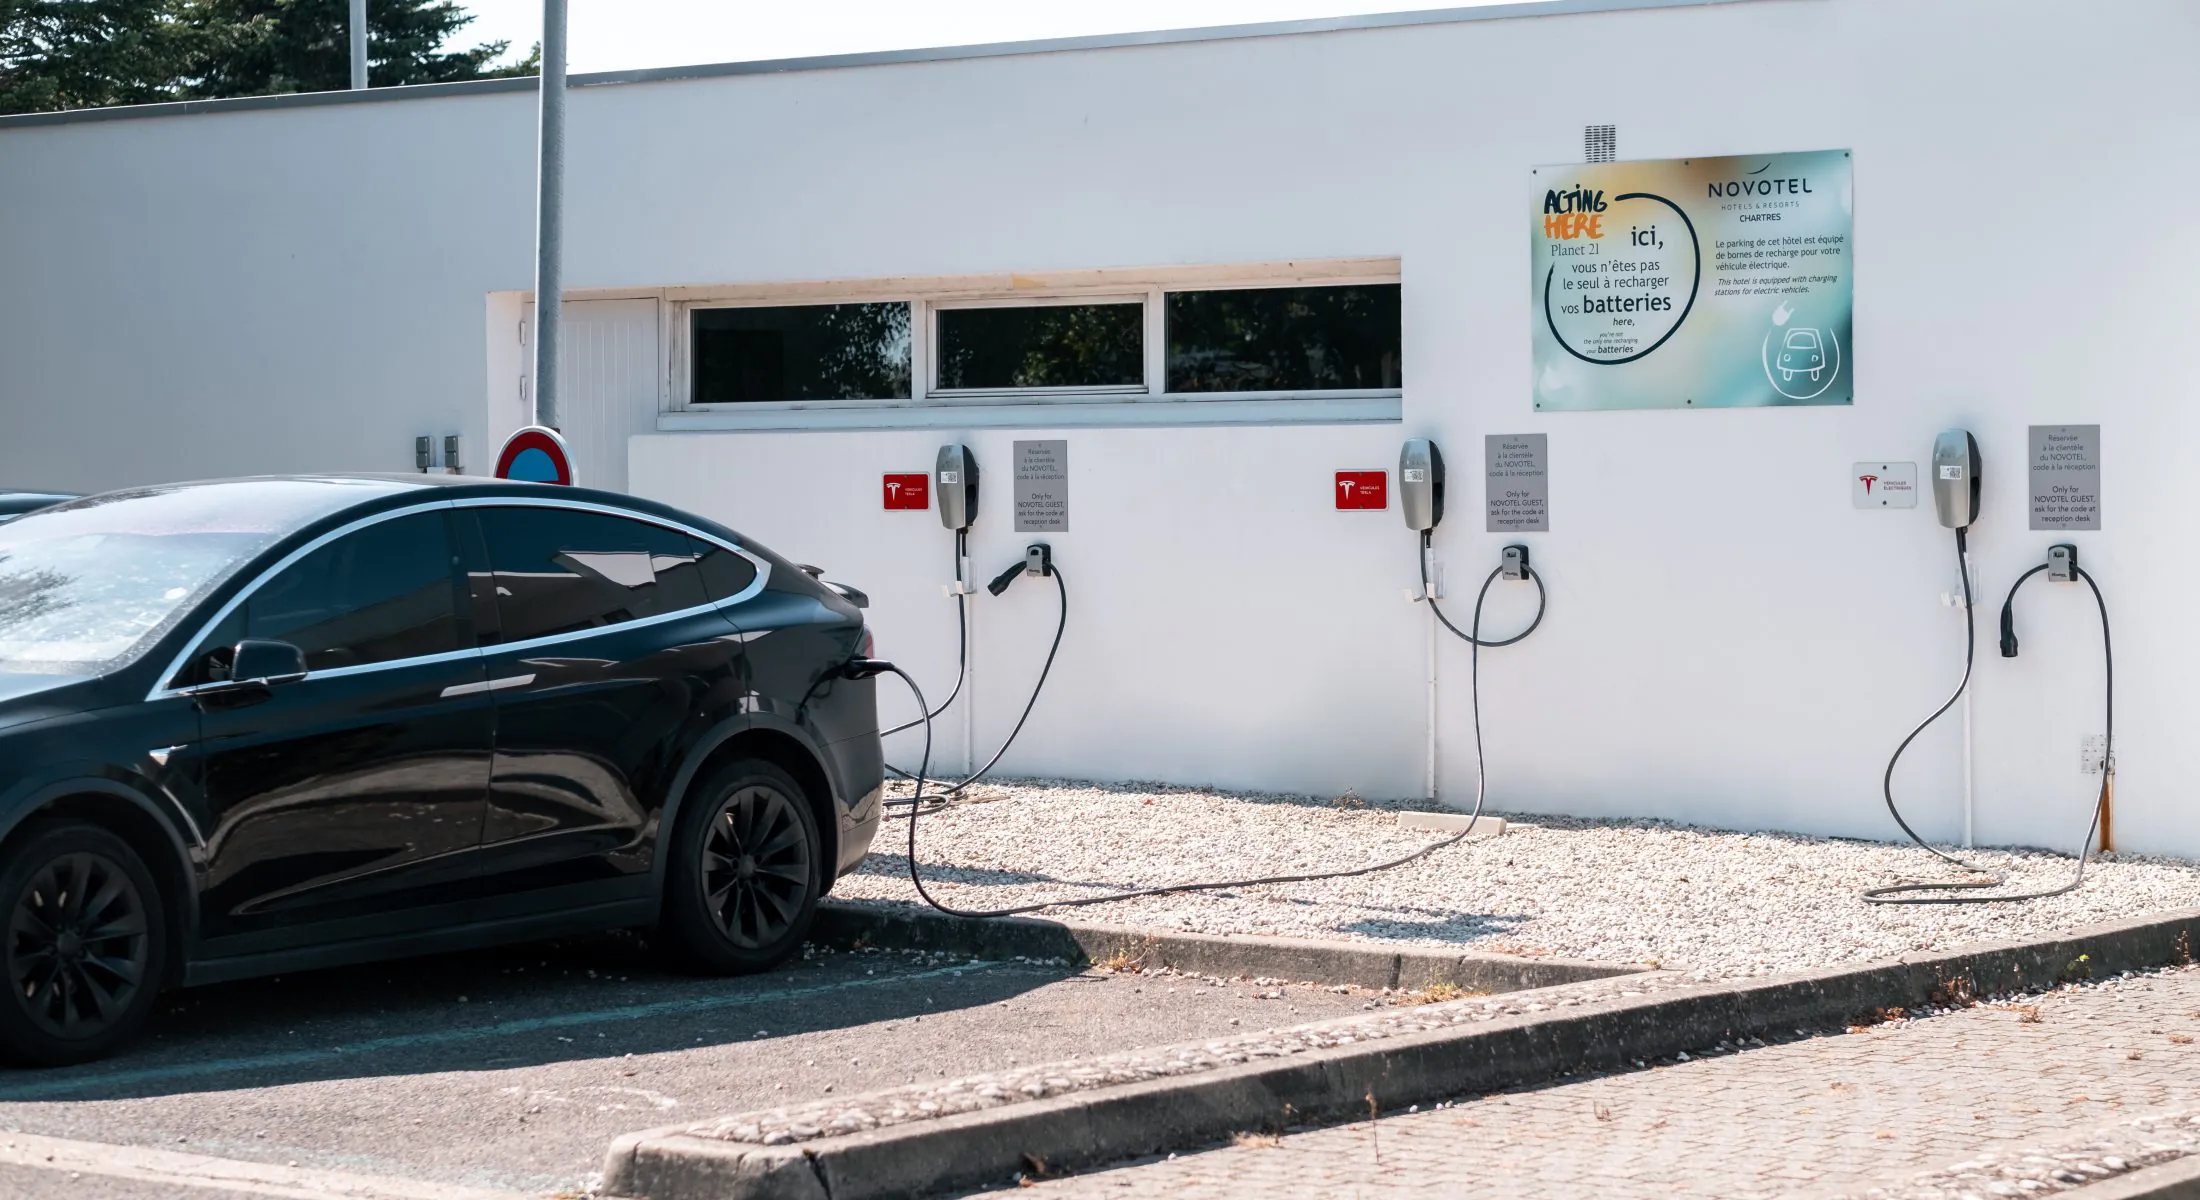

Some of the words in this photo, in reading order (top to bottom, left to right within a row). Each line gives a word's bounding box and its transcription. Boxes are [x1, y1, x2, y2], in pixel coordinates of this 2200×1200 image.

[1708, 178, 1812, 198] NOVOTEL
[1740, 213, 1781, 222] CHARTRES
[1544, 213, 1604, 240] HERE
[1631, 225, 1664, 250] ici,
[1716, 240, 1724, 248] Le
[1727, 239, 1754, 248] parking
[1756, 238, 1766, 246] de
[1783, 236, 1802, 245] hôtel
[1818, 234, 1844, 245] équipé
[1552, 244, 1585, 256] Planet
[1589, 244, 1599, 254] 21
[1716, 251, 1725, 260] de
[1766, 249, 1798, 258] recharge
[1801, 250, 1818, 258] pour
[1572, 263, 1597, 273] vous
[1600, 260, 1636, 272] n'êtes
[1640, 261, 1660, 274] pas
[1716, 262, 1746, 270] véhicule
[1749, 260, 1790, 270] électrique.
[1563, 278, 1574, 290] le
[1578, 277, 1600, 289] seul
[1604, 276, 1610, 288] à
[1614, 276, 1669, 290] recharger
[1759, 276, 1790, 285] equipped
[1809, 275, 1838, 284] charging
[1561, 305, 1579, 314] vos
[1584, 293, 1672, 314] batteries
[1613, 317, 1634, 326] here,
[1598, 345, 1634, 354] batteries
[1506, 490, 1520, 498] Only
[2052, 486, 2068, 494] Only
[2042, 515, 2073, 524] reception
